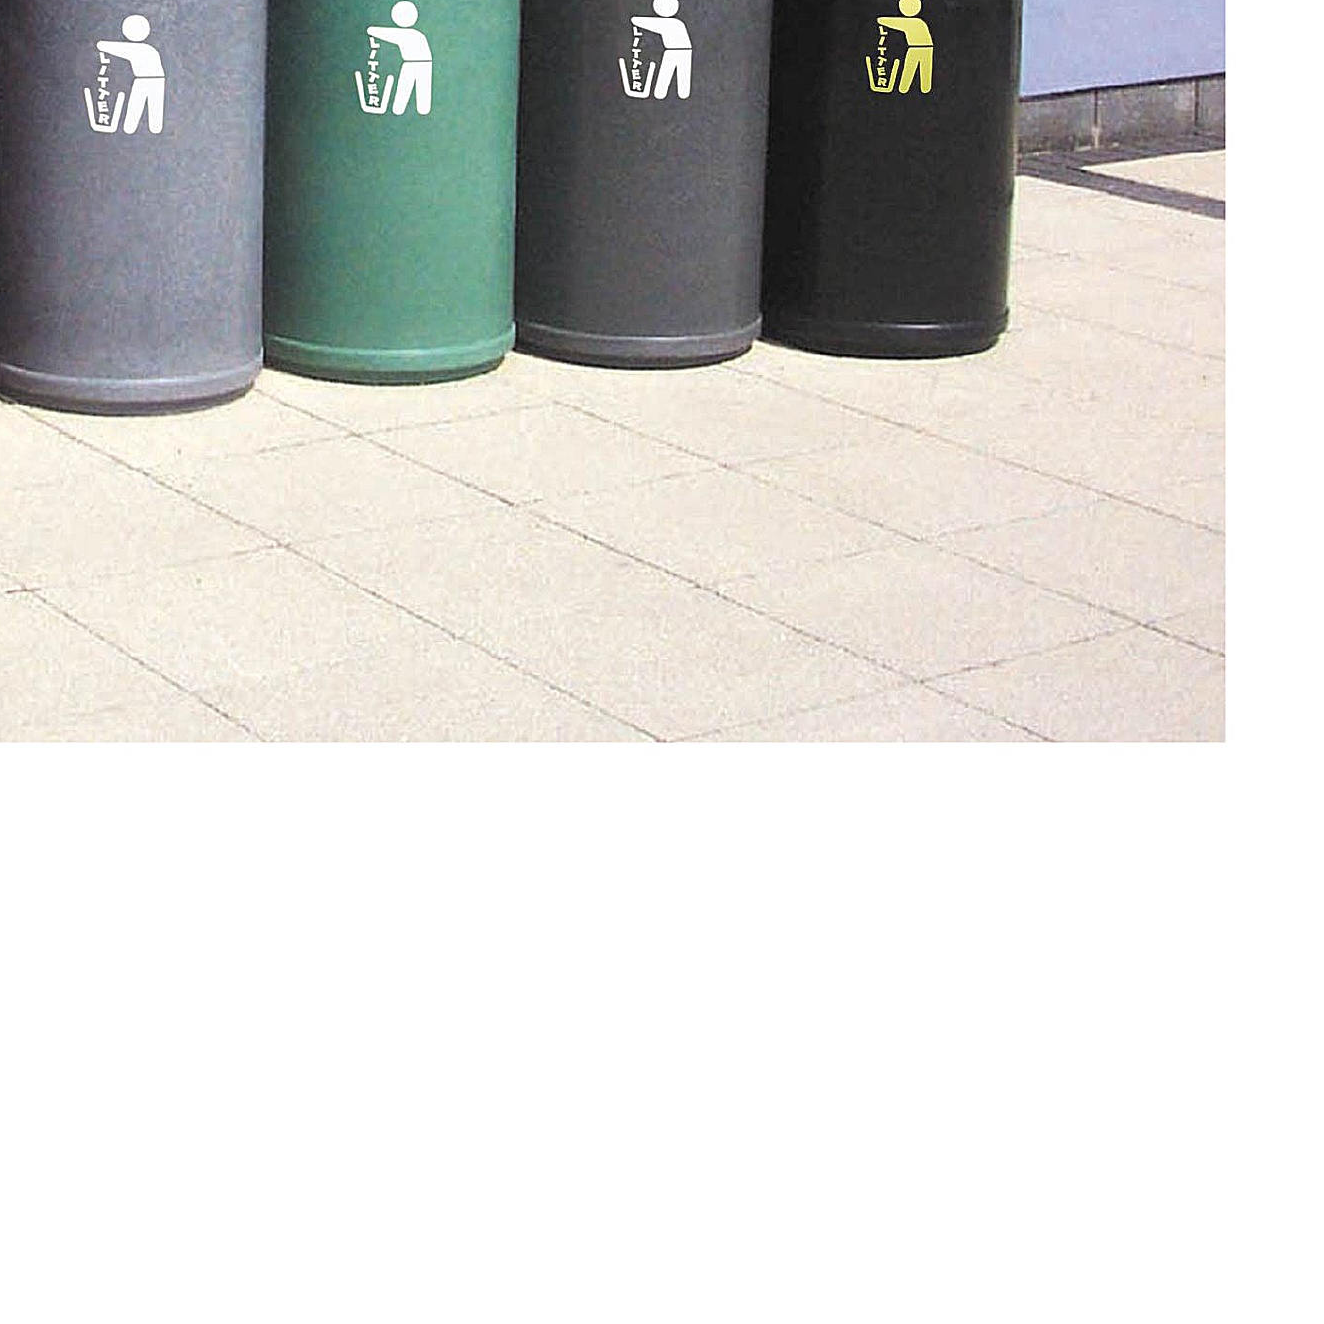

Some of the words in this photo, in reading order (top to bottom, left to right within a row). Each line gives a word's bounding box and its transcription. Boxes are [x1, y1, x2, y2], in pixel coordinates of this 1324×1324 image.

[97, 51, 111, 125] LITTER
[367, 36, 381, 107] LITTER
[631, 26, 643, 91] LITTER
[876, 25, 888, 87] LITTER
